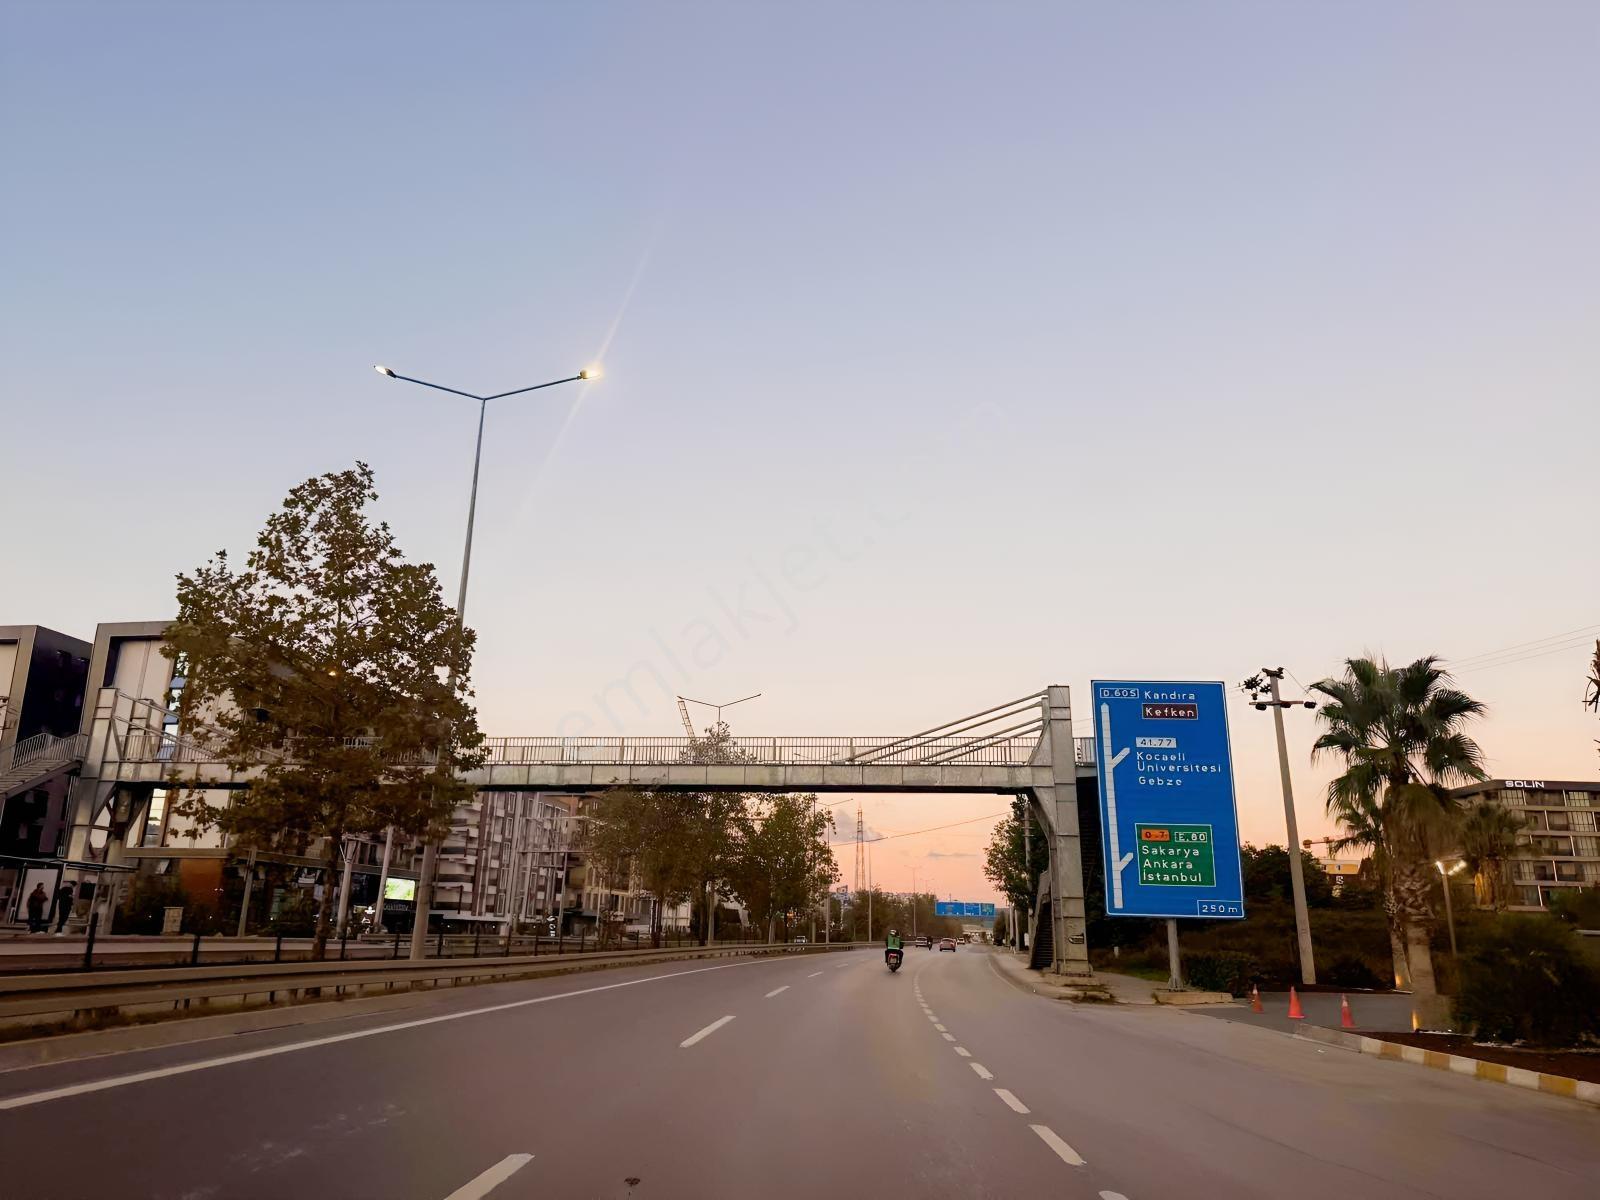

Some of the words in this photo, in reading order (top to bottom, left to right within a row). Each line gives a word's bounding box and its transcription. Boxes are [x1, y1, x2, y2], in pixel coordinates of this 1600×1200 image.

[1144, 690, 1195, 700] Kandıra
[1145, 707, 1195, 717] Kefken
[1140, 738, 1172, 746] 41.77
[1136, 751, 1185, 761] Kocaeli
[1138, 776, 1182, 786] Gebze
[1142, 845, 1200, 858] Sakarya
[1143, 858, 1193, 869] Ankara
[1202, 904, 1225, 913] 250
